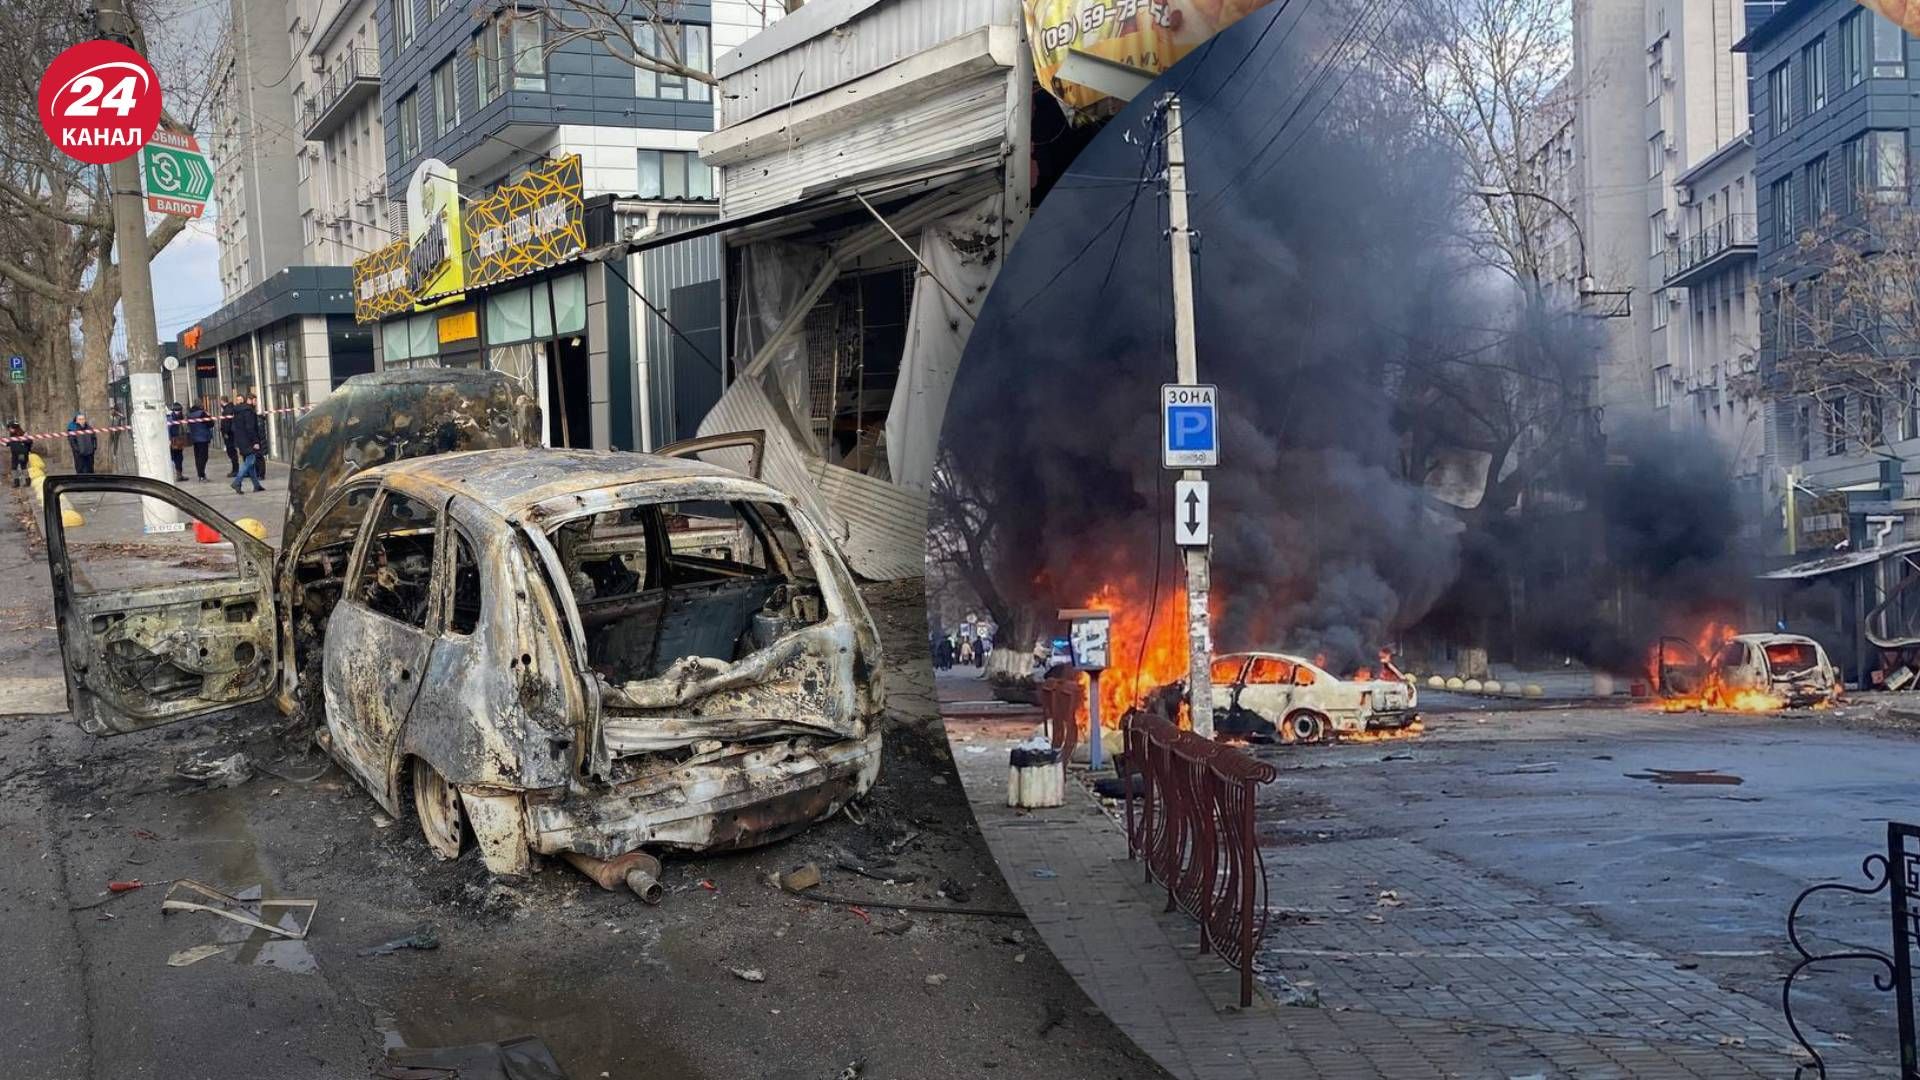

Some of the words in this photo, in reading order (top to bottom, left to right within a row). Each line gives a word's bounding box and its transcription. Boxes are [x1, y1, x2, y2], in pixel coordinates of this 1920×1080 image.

[152, 130, 189, 148] ОБМІН
[157, 199, 198, 215] ВАЛЮТ
[1168, 391, 1212, 404] ЗОНА
[1174, 411, 1208, 447] P
